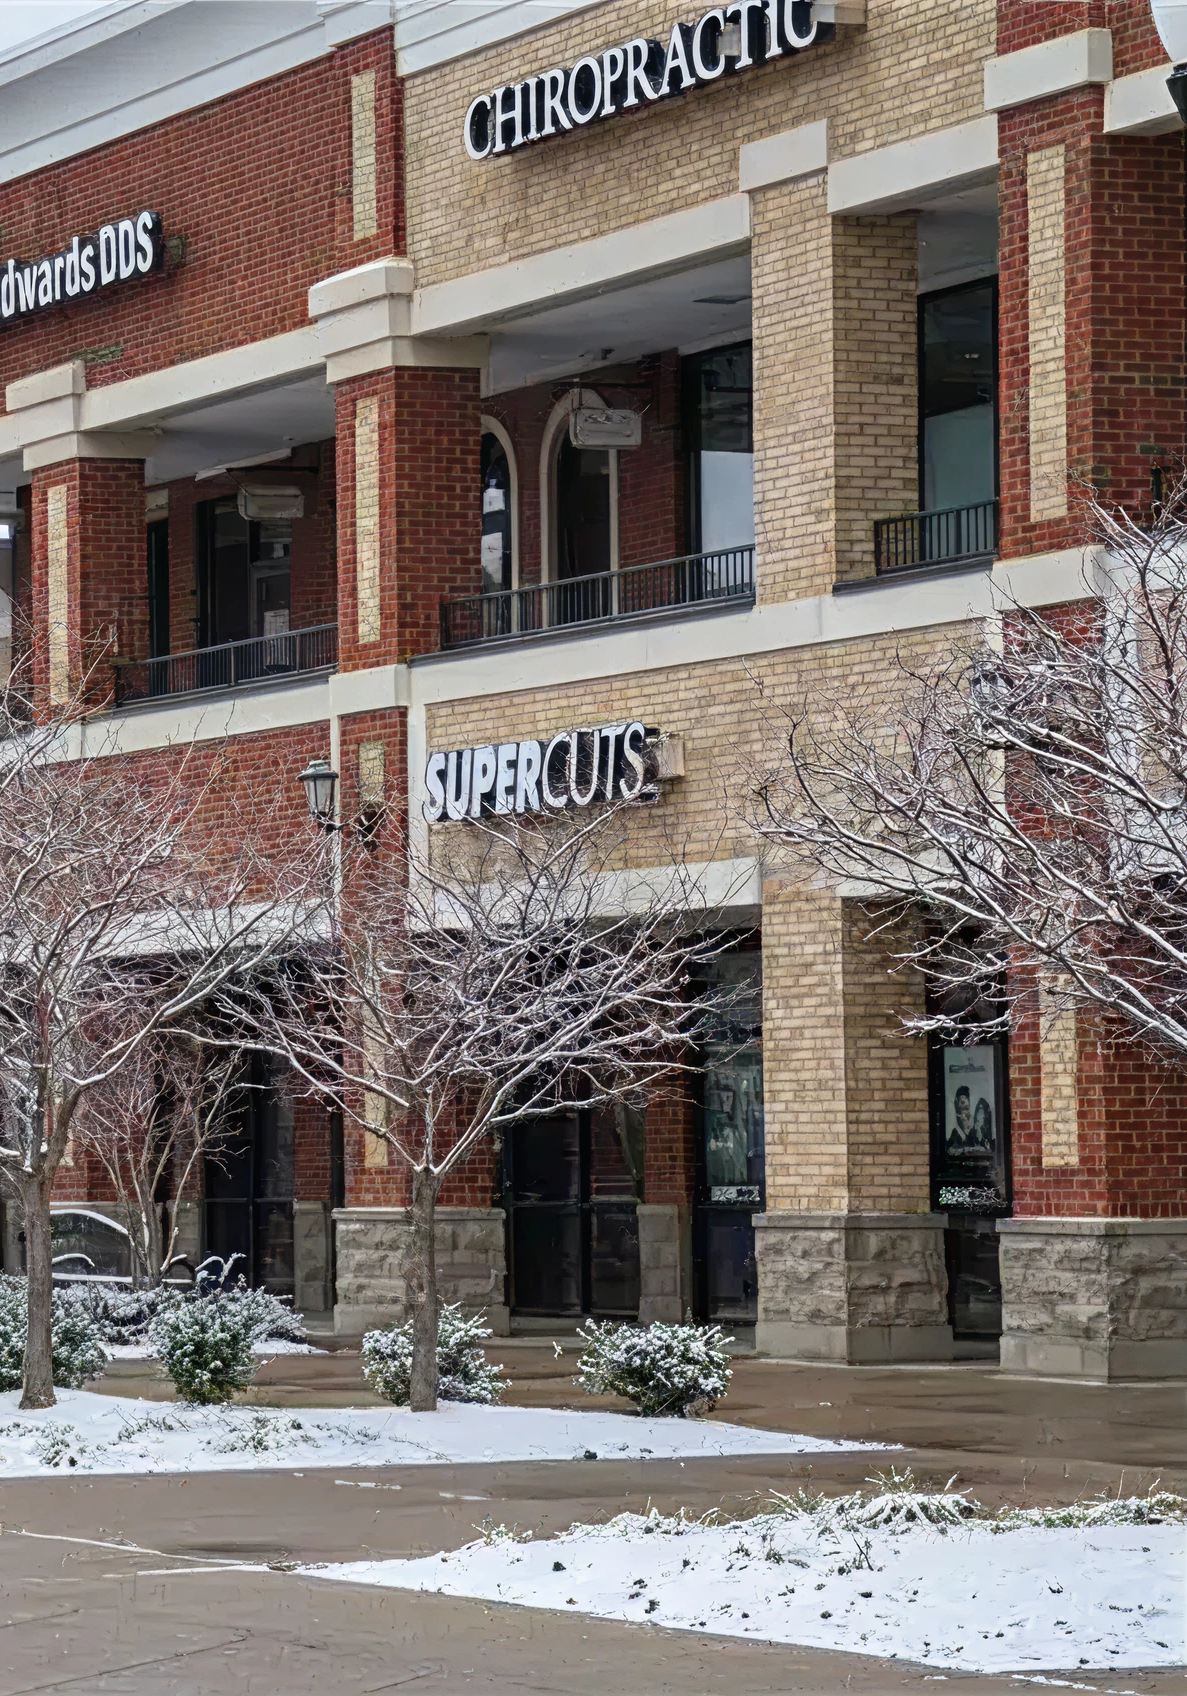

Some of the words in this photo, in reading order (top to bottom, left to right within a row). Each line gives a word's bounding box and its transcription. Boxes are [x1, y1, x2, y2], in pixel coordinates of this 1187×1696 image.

[464, 0, 818, 160] CHIROPRACTIC
[99, 210, 154, 286] DDS
[423, 720, 645, 825] SUPERCUTS
